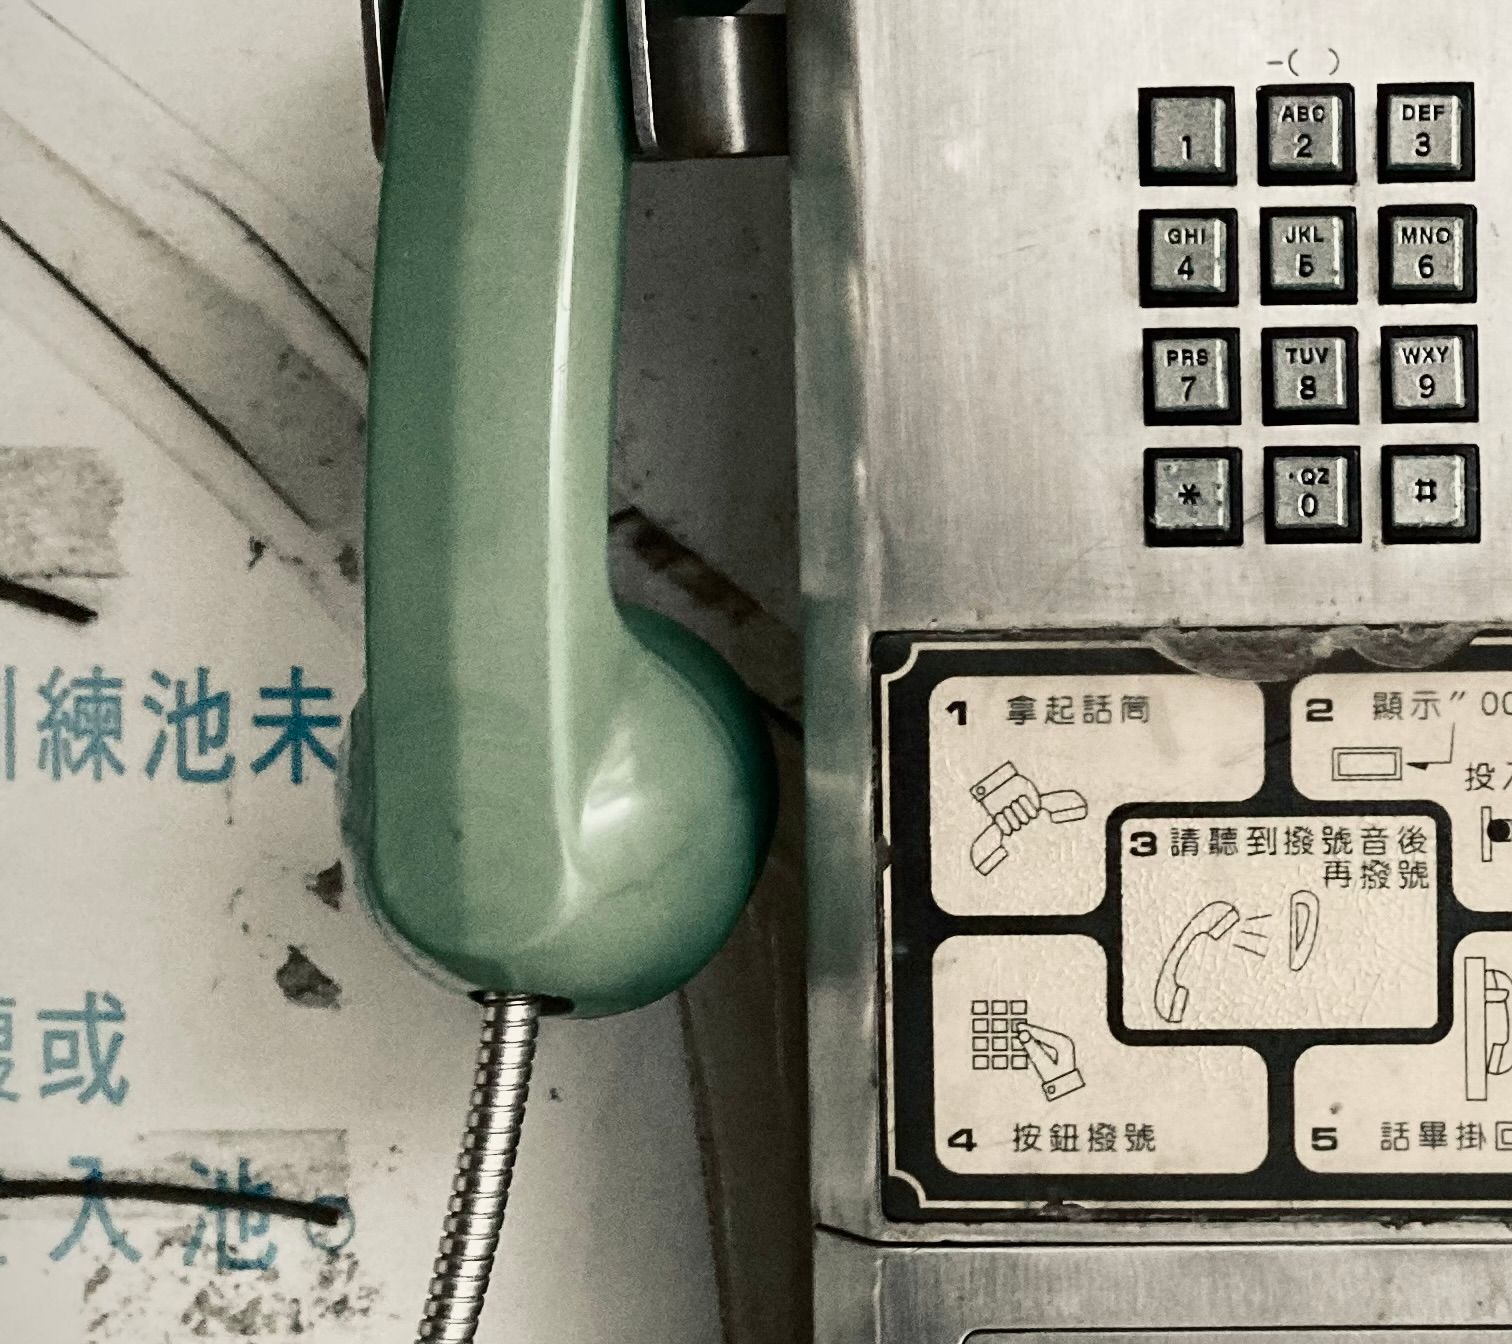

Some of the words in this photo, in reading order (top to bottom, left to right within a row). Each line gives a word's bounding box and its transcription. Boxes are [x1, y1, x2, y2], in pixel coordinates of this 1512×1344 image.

[1281, 104, 1326, 124] ABC
[1402, 103, 1445, 122] DEF
[1182, 134, 1192, 160] 1
[1296, 132, 1313, 159] 2
[1415, 130, 1432, 158] 3
[1168, 227, 1207, 245] GHI
[1285, 225, 1325, 244] JKL
[1401, 226, 1454, 246] MNO
[1177, 254, 1195, 280] 4
[1298, 253, 1315, 278] 5
[1418, 253, 1435, 279] 6
[1166, 347, 1209, 367] PRS
[1285, 346, 1330, 365] TUV
[1402, 345, 1449, 365] WXY
[1180, 375, 1197, 402] 7
[1300, 374, 1317, 401] 8
[1419, 372, 1436, 399] 9
[1301, 491, 1319, 519] 0
[945, 700, 967, 726] 1
[1007, 694, 1149, 726] 拿起話筒
[1305, 698, 1334, 723] 2
[4, 666, 343, 784] 練池未
[1129, 830, 1158, 858] 3
[1170, 825, 1427, 857] 請聽到撥號音後
[1323, 859, 1430, 890] 再撥號
[947, 1128, 978, 1152] 4
[1012, 1122, 1156, 1153] 按鈕撥號
[1311, 1126, 1339, 1152] 5
